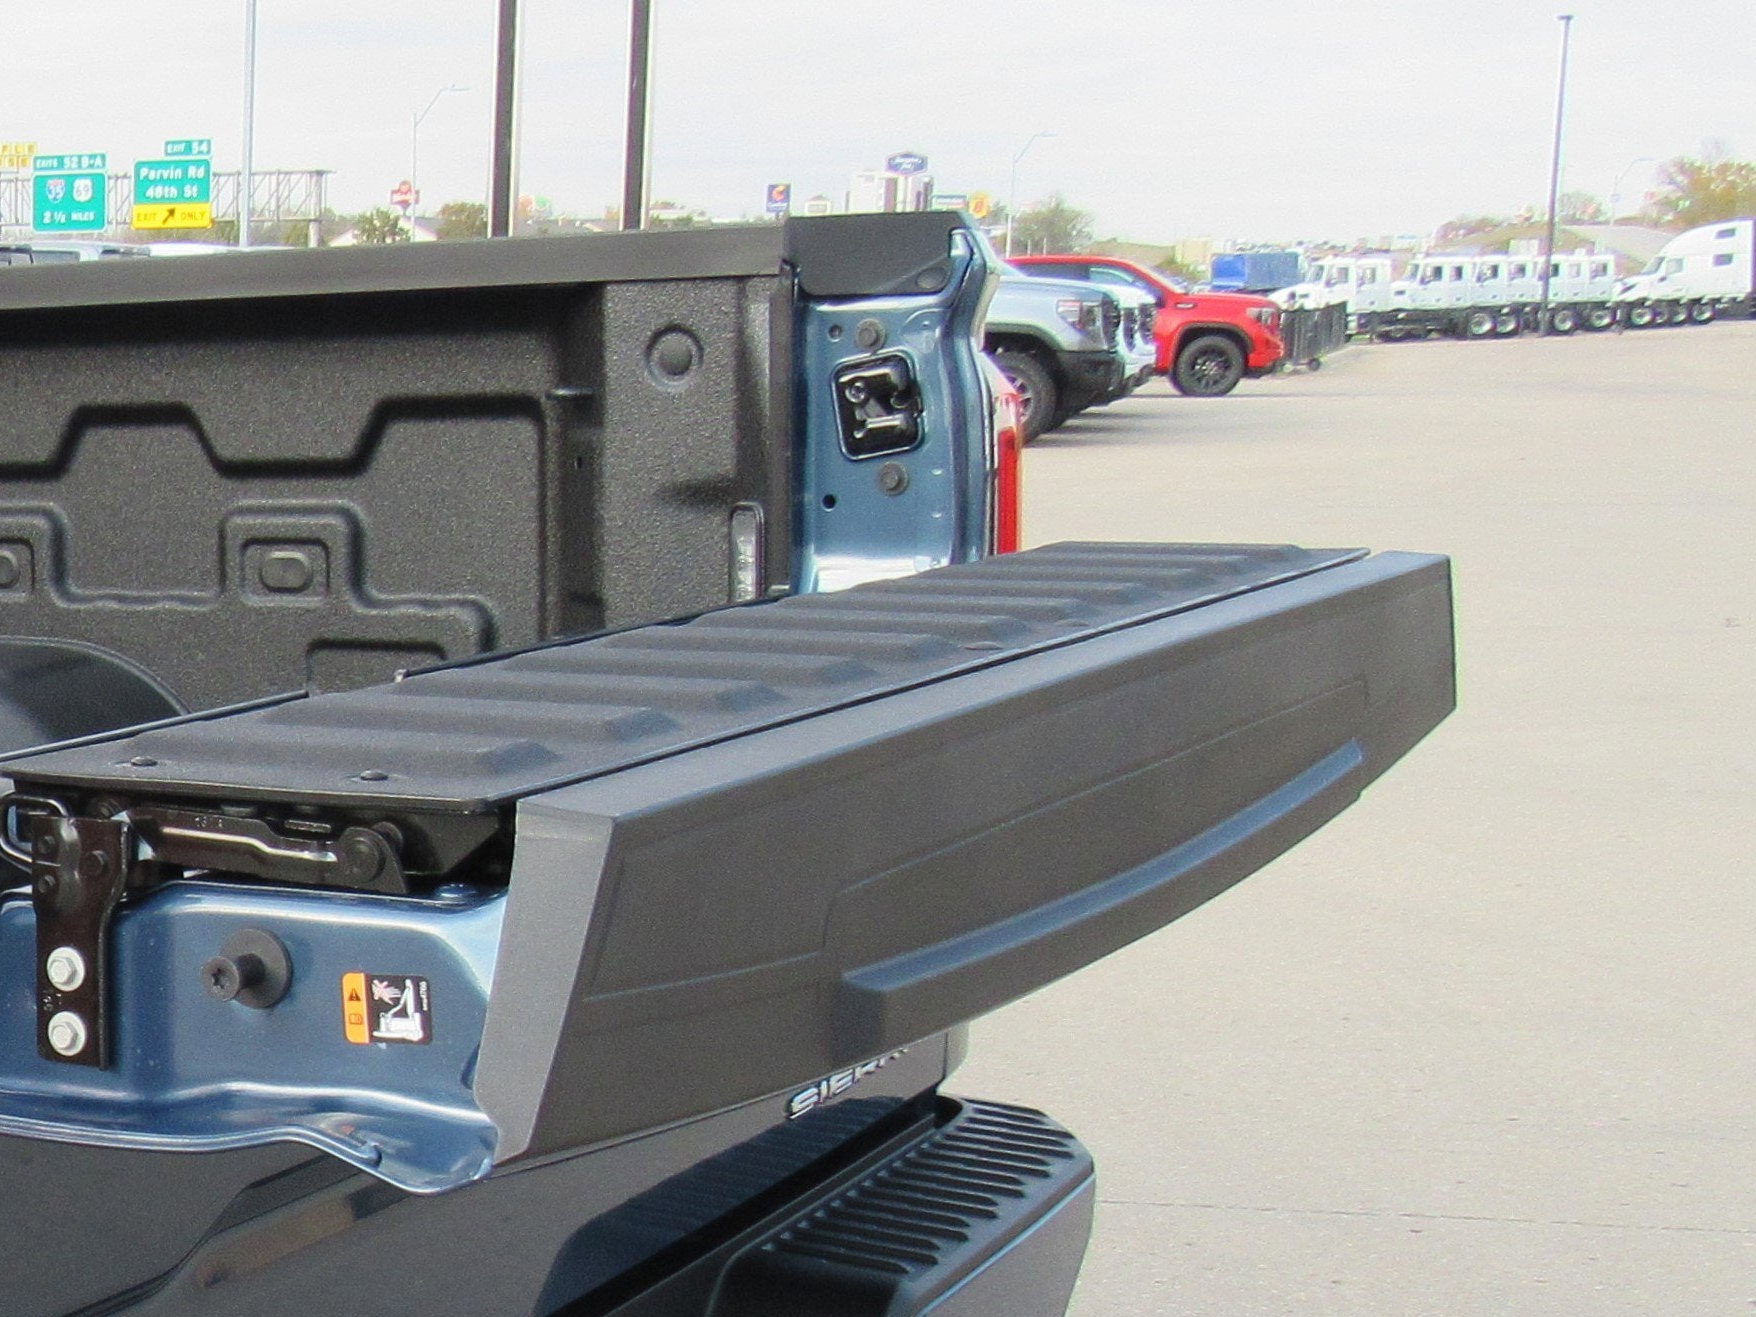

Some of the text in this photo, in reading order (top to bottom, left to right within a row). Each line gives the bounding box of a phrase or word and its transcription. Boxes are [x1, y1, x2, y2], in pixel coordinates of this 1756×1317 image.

[167, 141, 208, 153] EXIT 54
[36, 158, 58, 169] EXITS
[139, 164, 205, 181] Parvin Rd
[48, 185, 63, 195] 35
[75, 184, 90, 198] 69
[183, 184, 198, 198] St
[71, 210, 96, 222] MILES
[136, 211, 207, 222] EXIT ONLY
